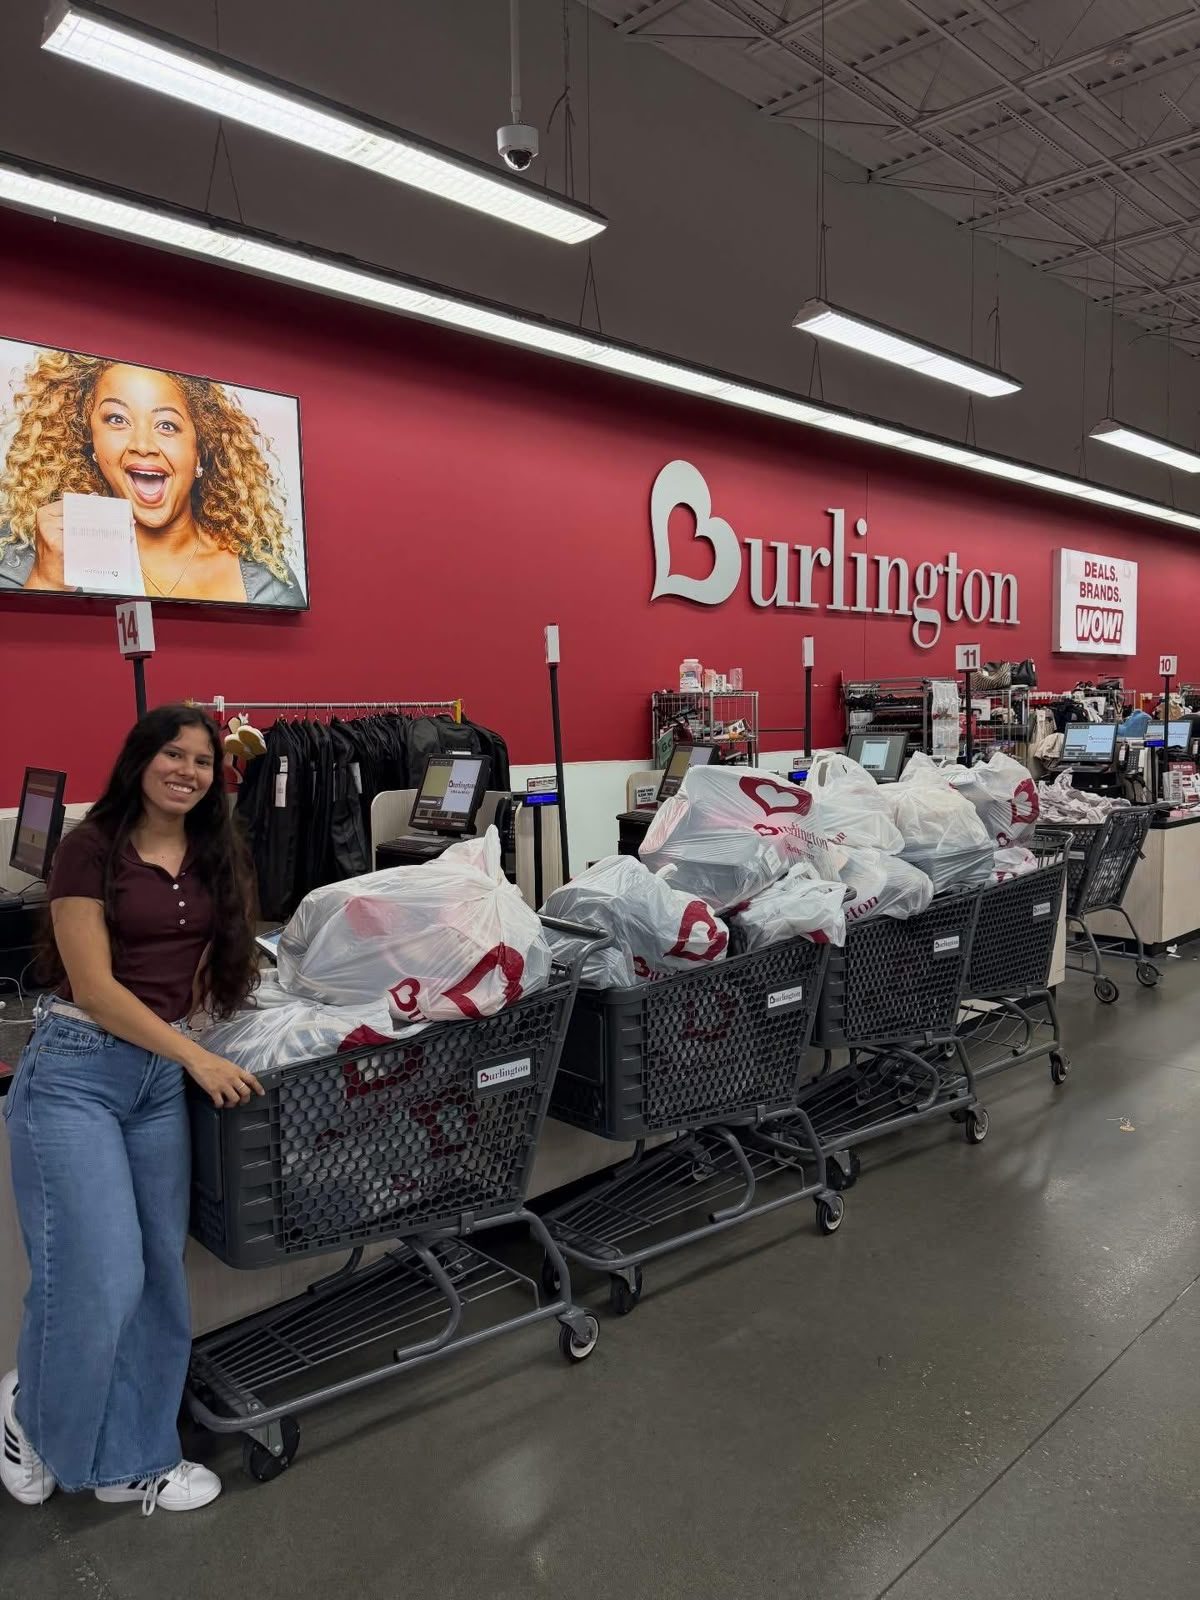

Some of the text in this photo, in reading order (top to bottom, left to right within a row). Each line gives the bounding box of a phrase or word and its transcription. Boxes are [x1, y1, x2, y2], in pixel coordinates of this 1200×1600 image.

[650, 459, 1020, 650] Burlington
[1084, 560, 1118, 583] DEALS.
[1079, 581, 1122, 603] BRANDS.
[118, 610, 138, 646] 14
[1075, 605, 1124, 643] WOW!
[963, 649, 978, 668] 11
[1160, 658, 1171, 673] 10
[769, 989, 801, 1004] Burlington
[480, 1063, 528, 1083] Burlington
